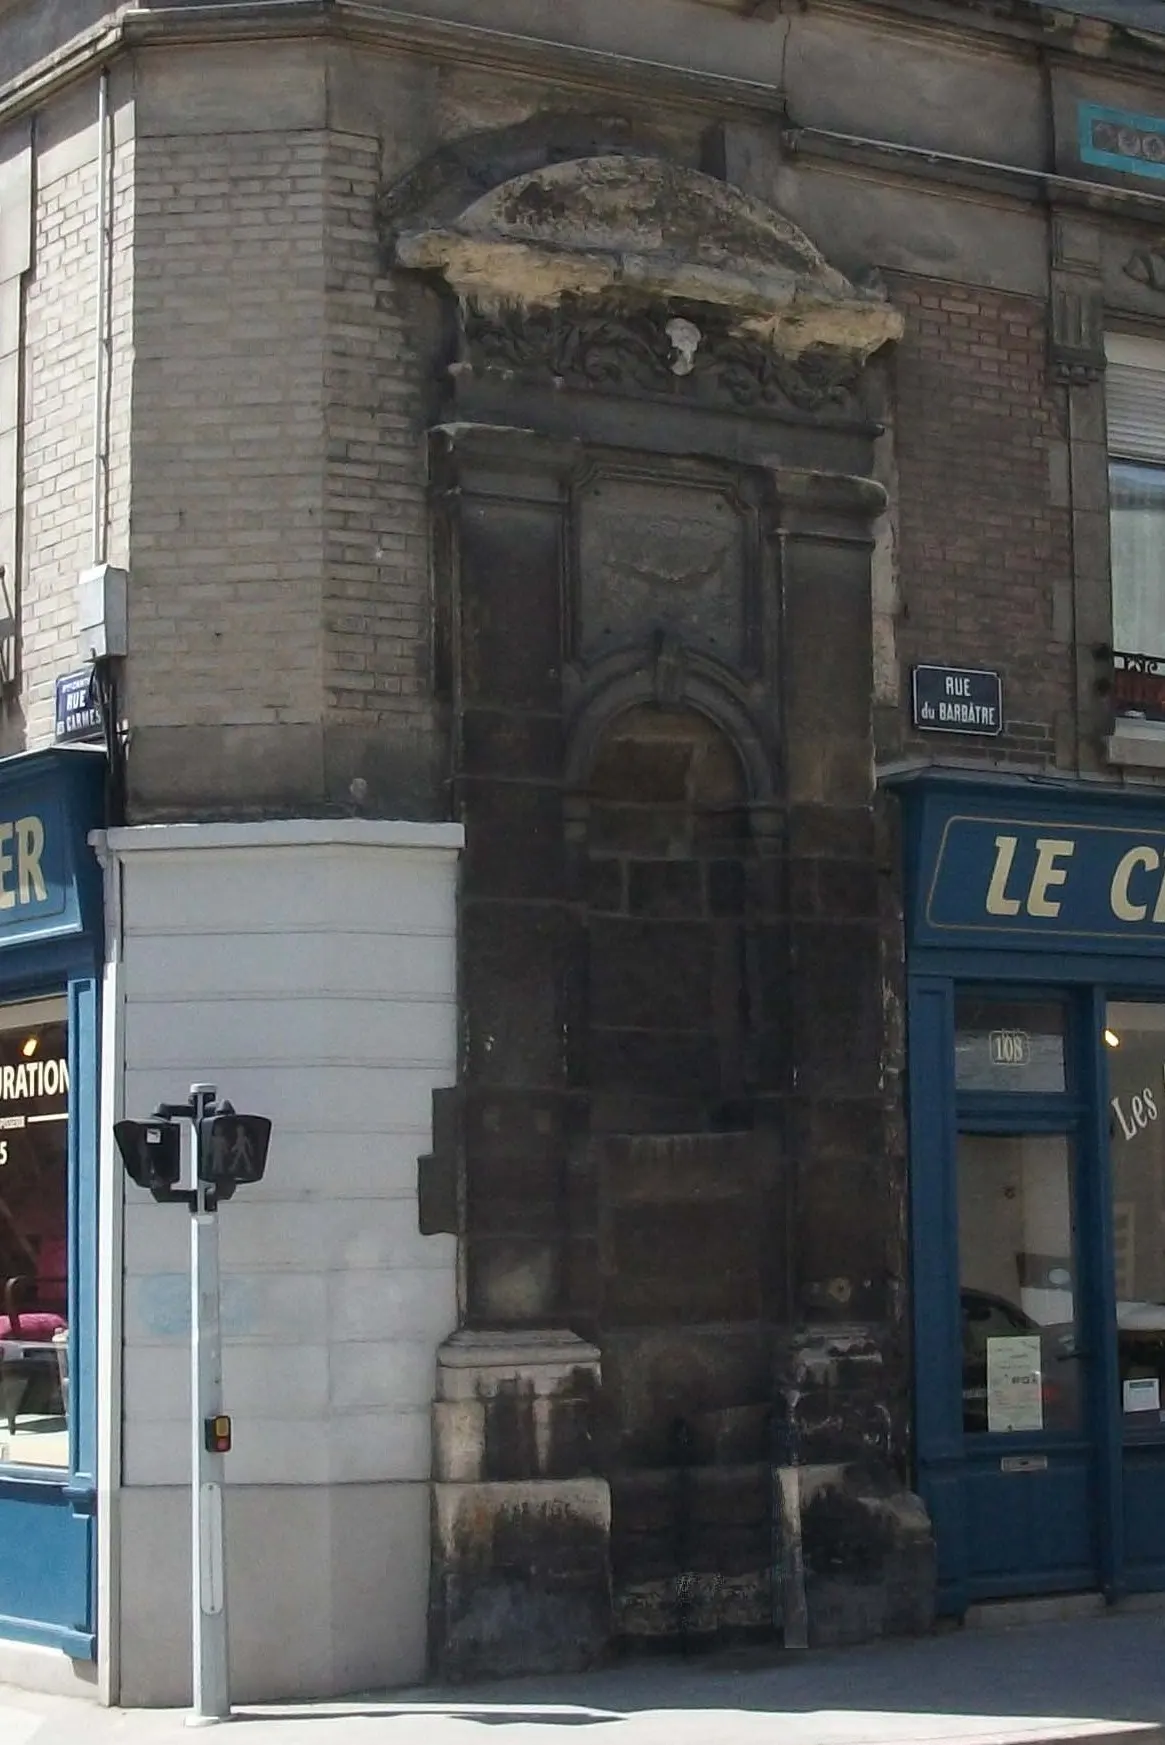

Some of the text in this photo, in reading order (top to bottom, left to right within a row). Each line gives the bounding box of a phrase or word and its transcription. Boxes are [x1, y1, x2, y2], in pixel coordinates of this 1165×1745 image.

[945, 676, 972, 697] RUE
[66, 689, 87, 711] RUE
[66, 708, 101, 732] CARMES
[921, 701, 996, 726] du BARBÂTRE
[985, 835, 1075, 918] LE
[995, 1035, 1023, 1062] 108
[1110, 1087, 1158, 1141] Les
